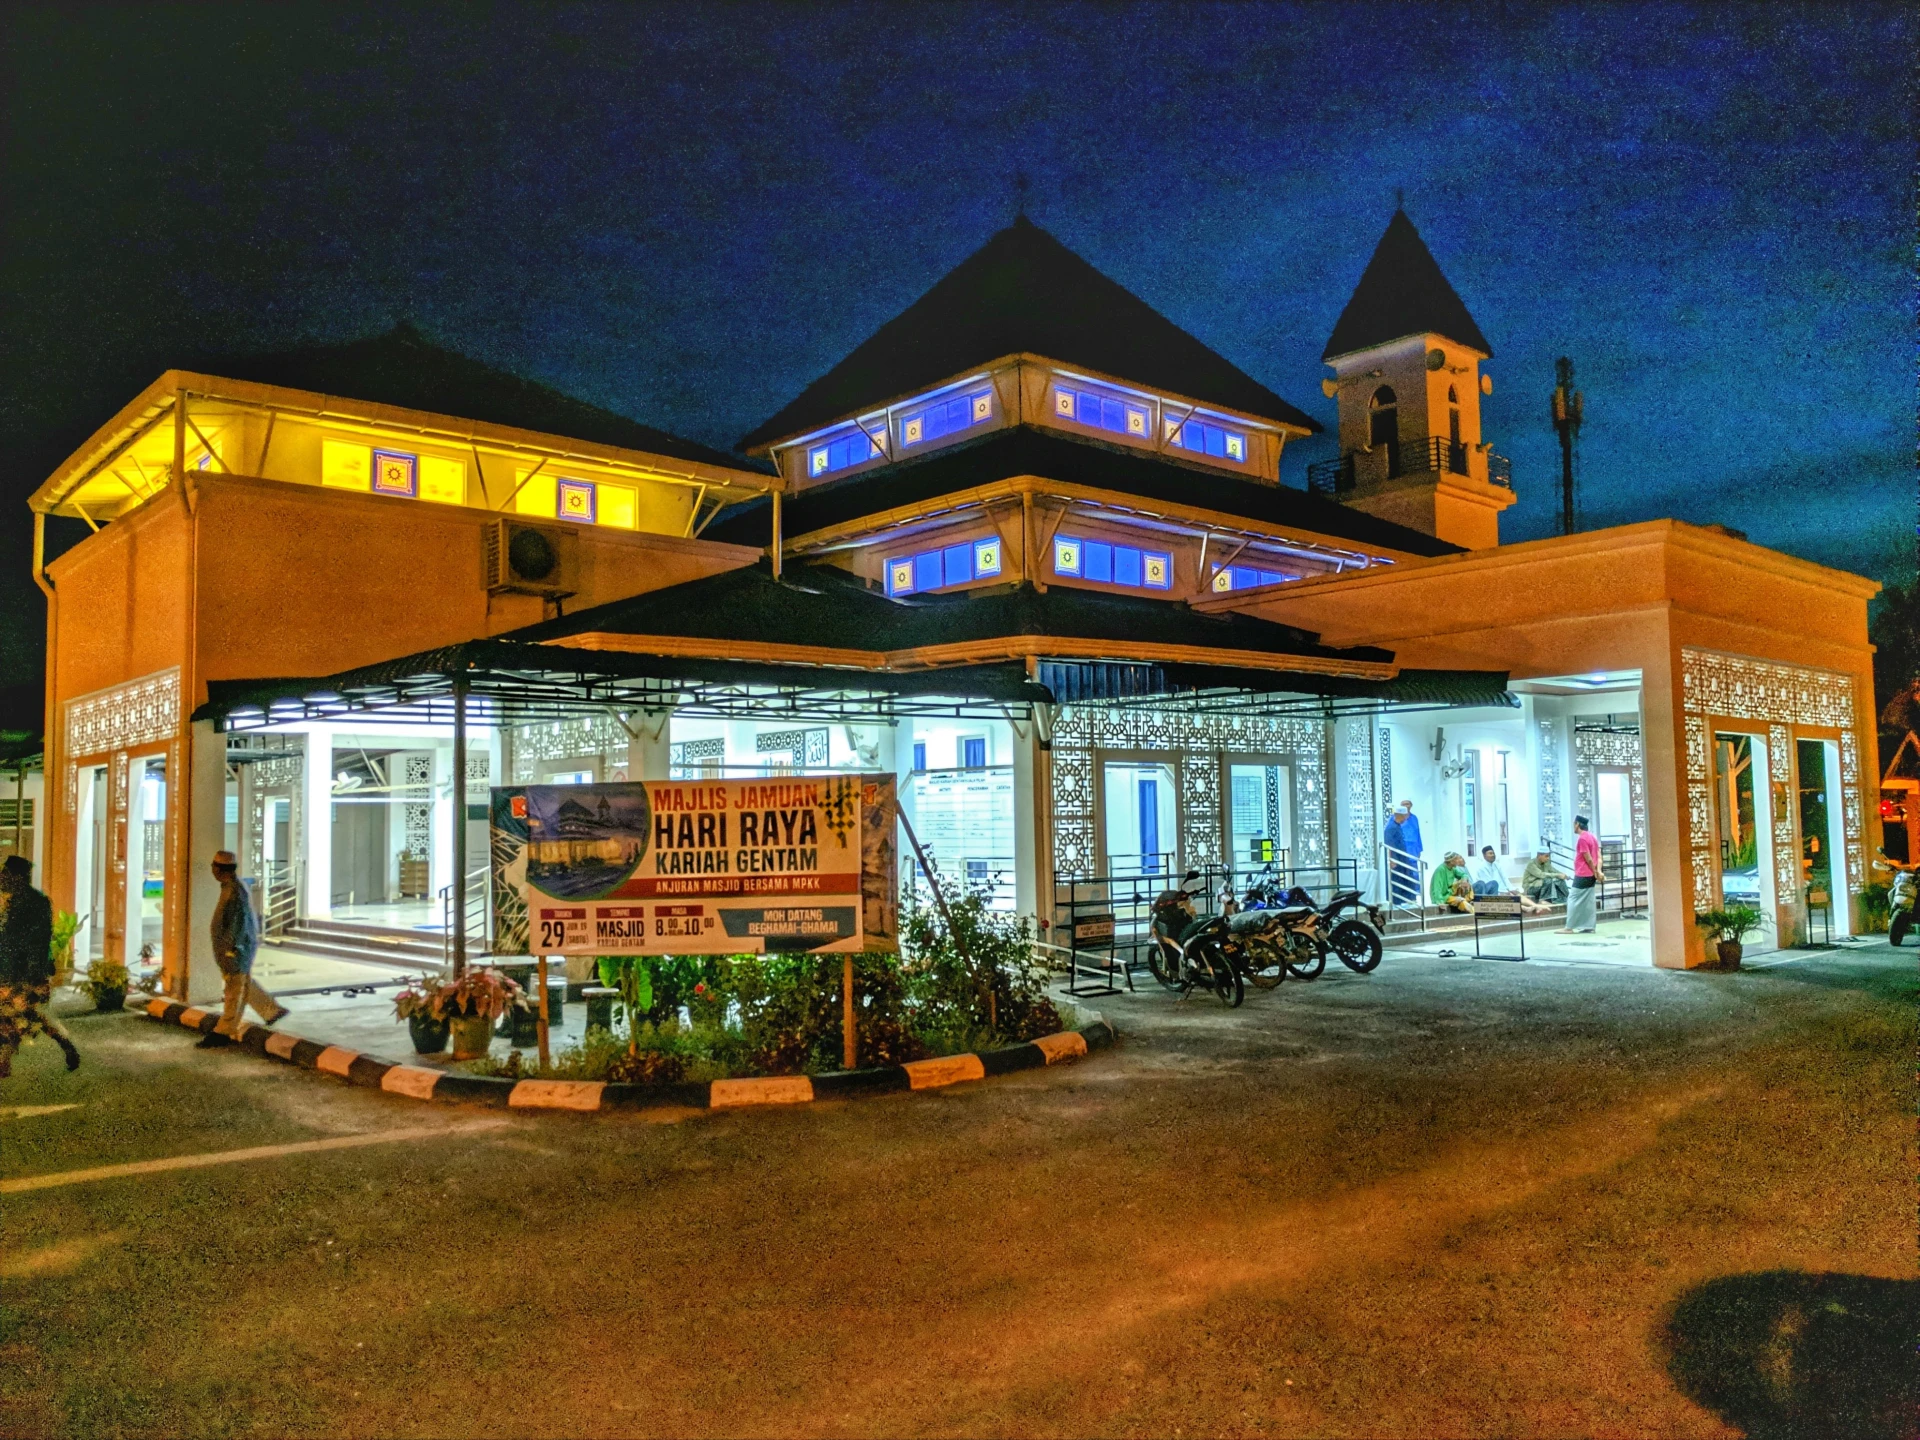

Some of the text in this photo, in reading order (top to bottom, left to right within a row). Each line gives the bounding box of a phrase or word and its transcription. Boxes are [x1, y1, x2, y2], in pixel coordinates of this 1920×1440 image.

[654, 784, 818, 811] MAJLIS JAMUAN
[655, 809, 818, 849] HARI RAYA
[656, 848, 818, 875] KARIAH GENTAM
[655, 877, 820, 893] ANJURAN MASJID BERSAMA MPKK
[763, 909, 823, 921] MOH DATANG
[541, 921, 565, 948] 29
[596, 920, 645, 938] MASJID
